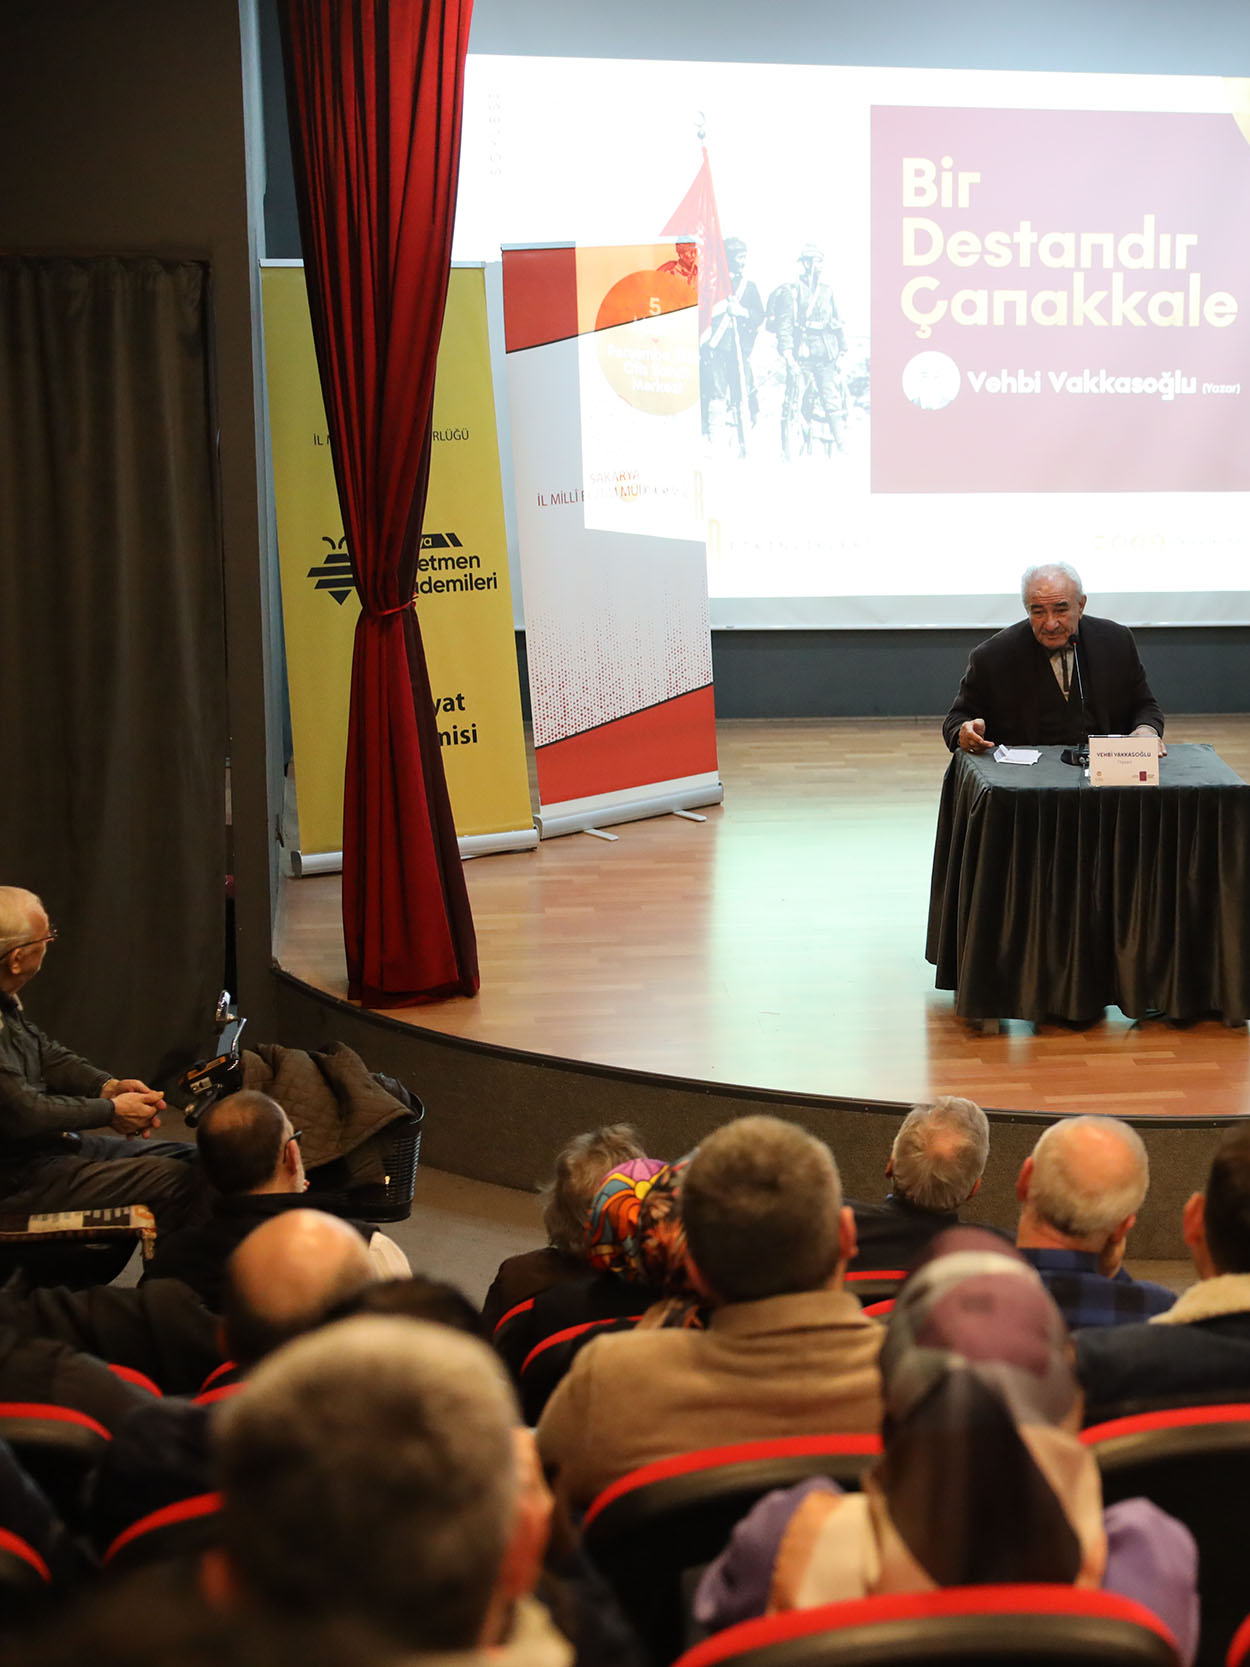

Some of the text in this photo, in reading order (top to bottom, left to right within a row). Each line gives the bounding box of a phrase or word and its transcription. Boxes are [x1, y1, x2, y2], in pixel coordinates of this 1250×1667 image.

[901, 156, 981, 209] Bir
[901, 214, 1198, 270] Destandır
[900, 272, 1239, 339] Çanakkale
[967, 369, 1241, 400] Vehbi Vakkasoğlu (Yazar)
[432, 428, 470, 442] RLÜĞÜ
[537, 493, 548, 507] İL
[550, 489, 578, 505] MİLLİ
[418, 555, 481, 572] etmen
[416, 572, 498, 594] demileri
